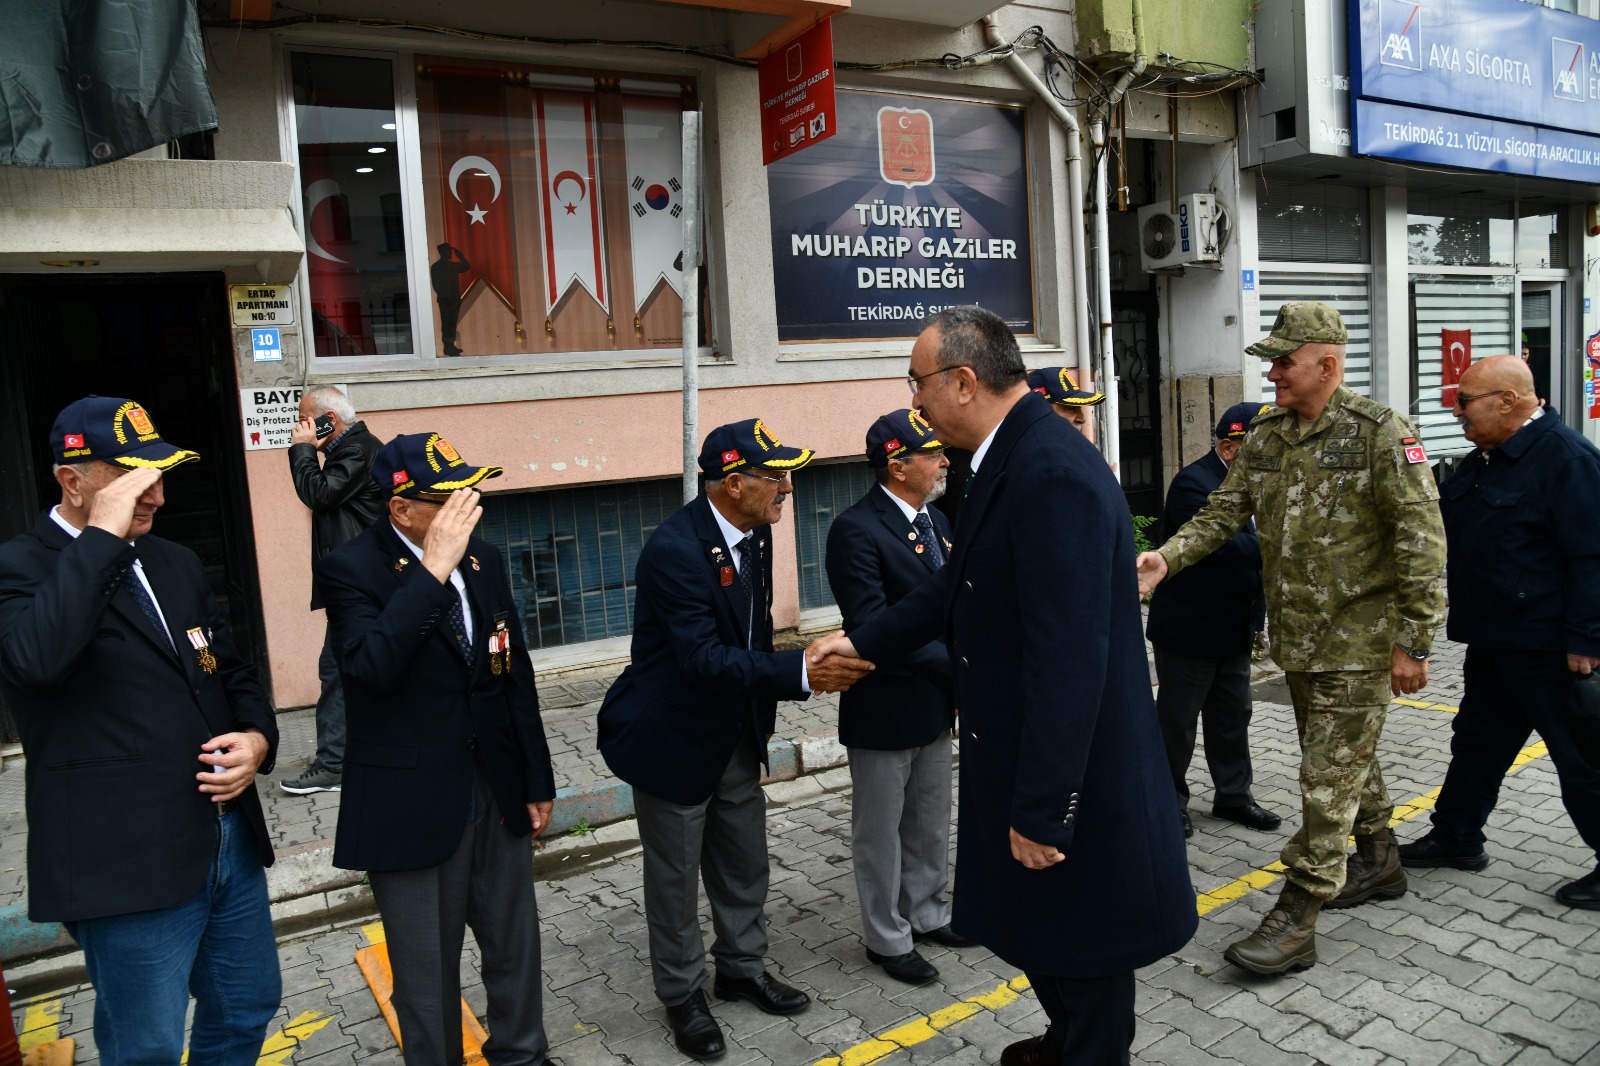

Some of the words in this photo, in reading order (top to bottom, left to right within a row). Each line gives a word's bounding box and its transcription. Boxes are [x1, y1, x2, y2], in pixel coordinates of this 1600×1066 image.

[1381, 33, 1414, 62] AXA
[1429, 43, 1461, 73] AXA
[1465, 47, 1532, 86] SİGORTA
[1554, 70, 1579, 95] AXA
[1384, 121, 1444, 147] TEKİRDAĞ
[1446, 131, 1463, 149] 21.
[1466, 133, 1502, 154] YÜZYIL
[1504, 136, 1548, 160] SİGORTA
[1549, 145, 1592, 165] ARACILIK
[1179, 204, 1190, 252] BEKO
[247, 289, 276, 299] ERTAÇ
[236, 301, 289, 310] APARTMANI
[848, 302, 925, 321] TEKİRDAĞ
[251, 312, 276, 321] NO:10
[258, 334, 273, 346] 10
[246, 417, 261, 427] Diş
[262, 415, 291, 426] Protez
[268, 438, 285, 446] Tel:
